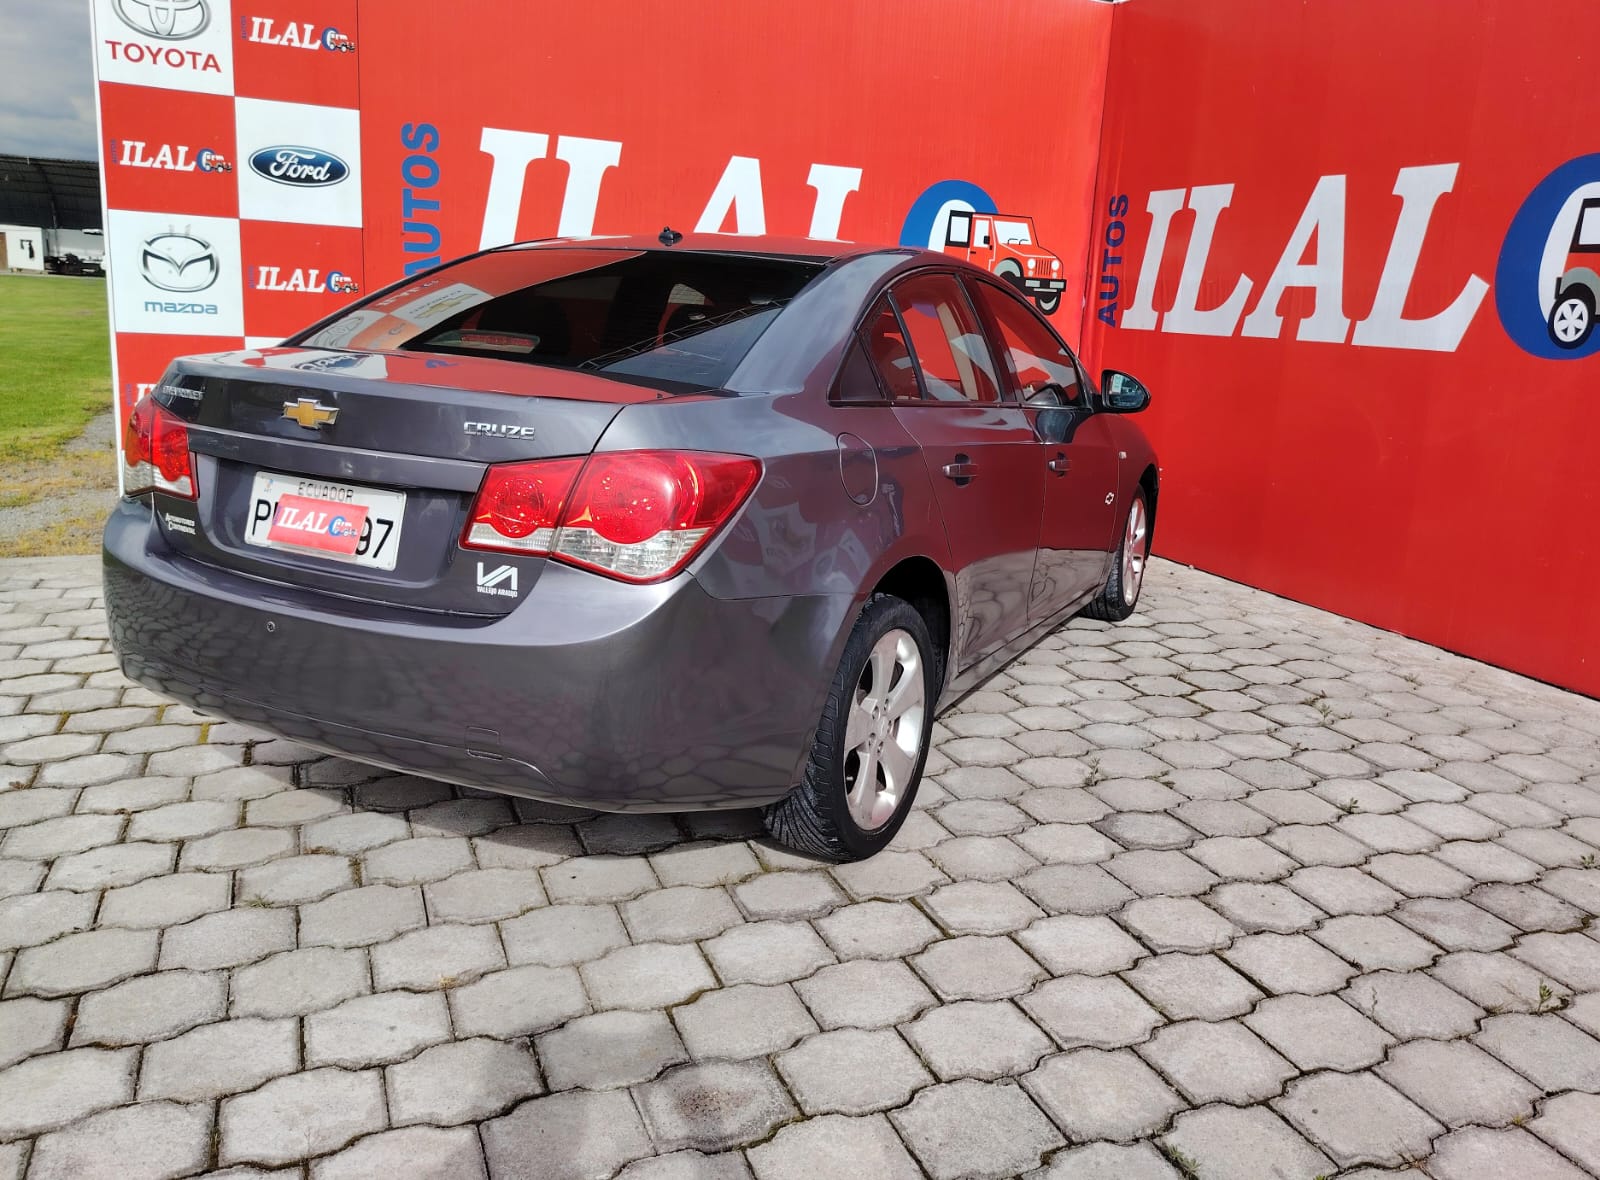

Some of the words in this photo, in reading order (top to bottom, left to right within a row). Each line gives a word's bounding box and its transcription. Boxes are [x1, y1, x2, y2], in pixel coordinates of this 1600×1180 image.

[105, 40, 221, 73] TOYOTA
[269, 150, 331, 181] Ford
[1097, 194, 1129, 327] AUTOS
[144, 301, 218, 315] mazda
[463, 422, 535, 440] CRUZE
[298, 481, 354, 502] ECUADOR
